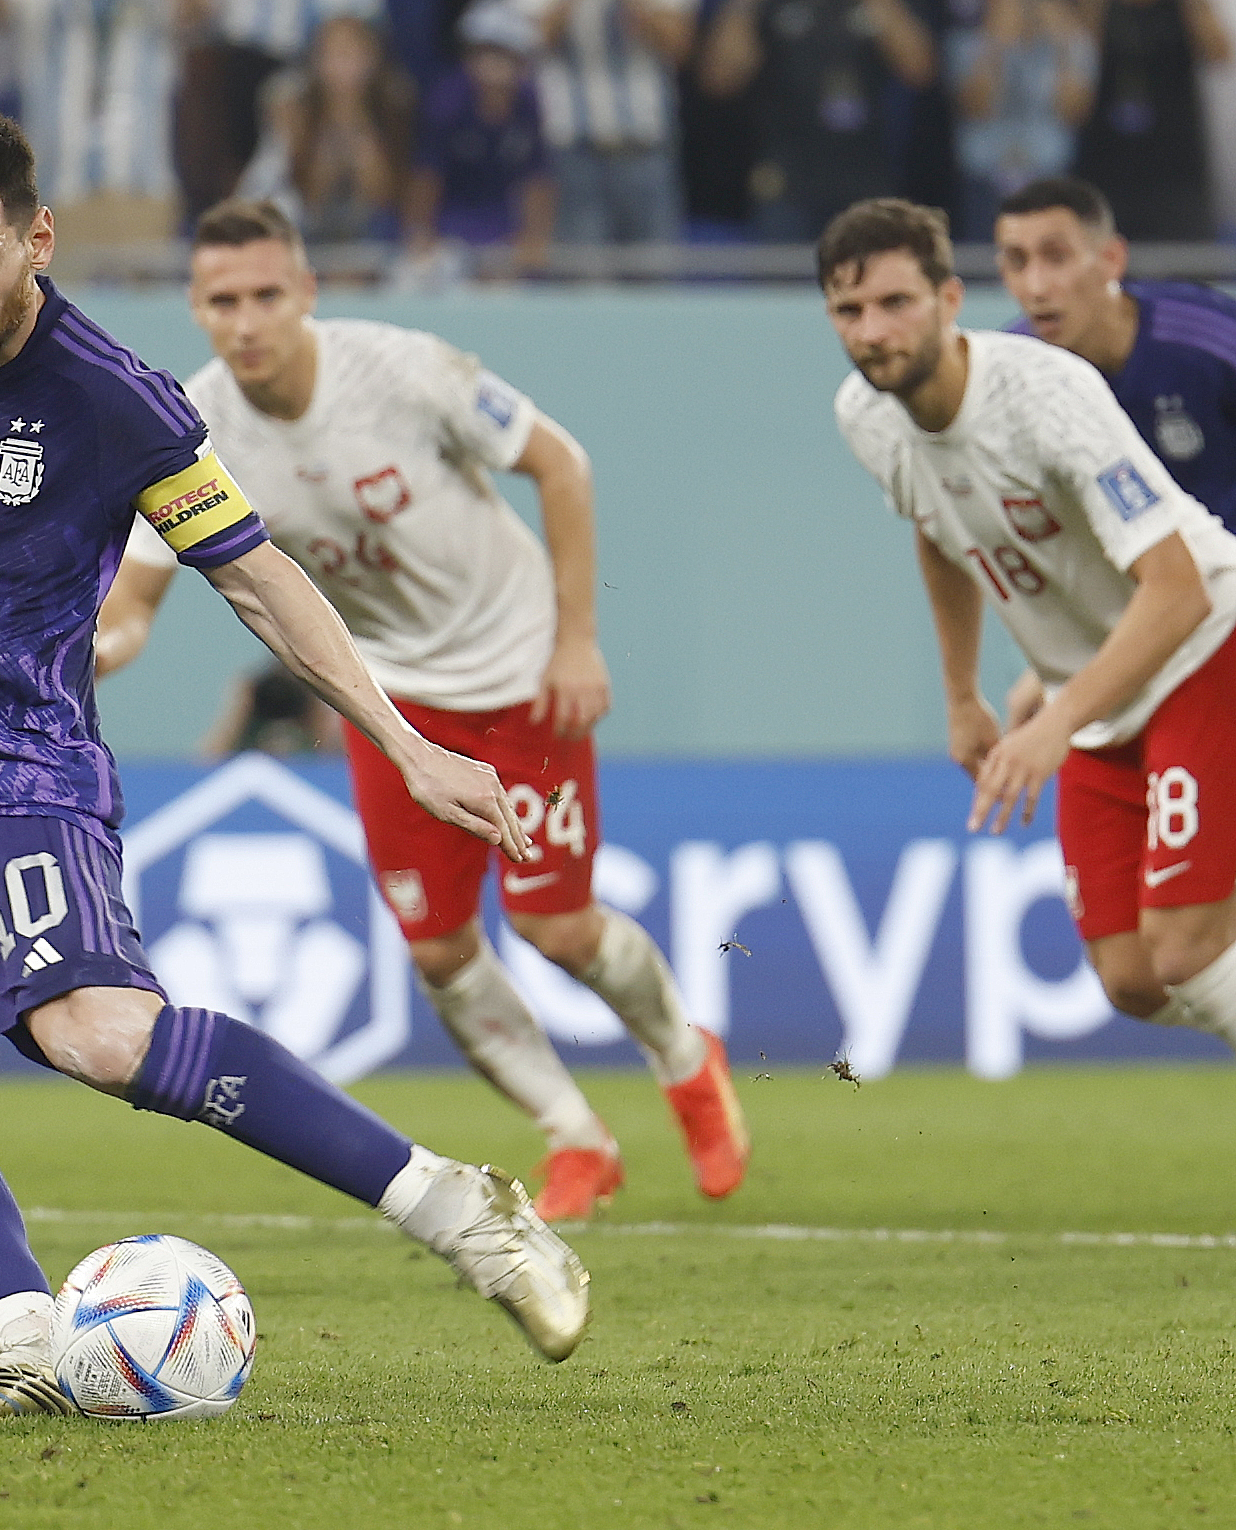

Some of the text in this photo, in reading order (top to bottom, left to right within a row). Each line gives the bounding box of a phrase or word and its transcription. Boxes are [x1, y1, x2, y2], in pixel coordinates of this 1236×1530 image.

[2, 456, 30, 487] AFA
[964, 545, 1045, 602] 18
[507, 778, 586, 862] 24
[1146, 765, 1200, 851] 18
